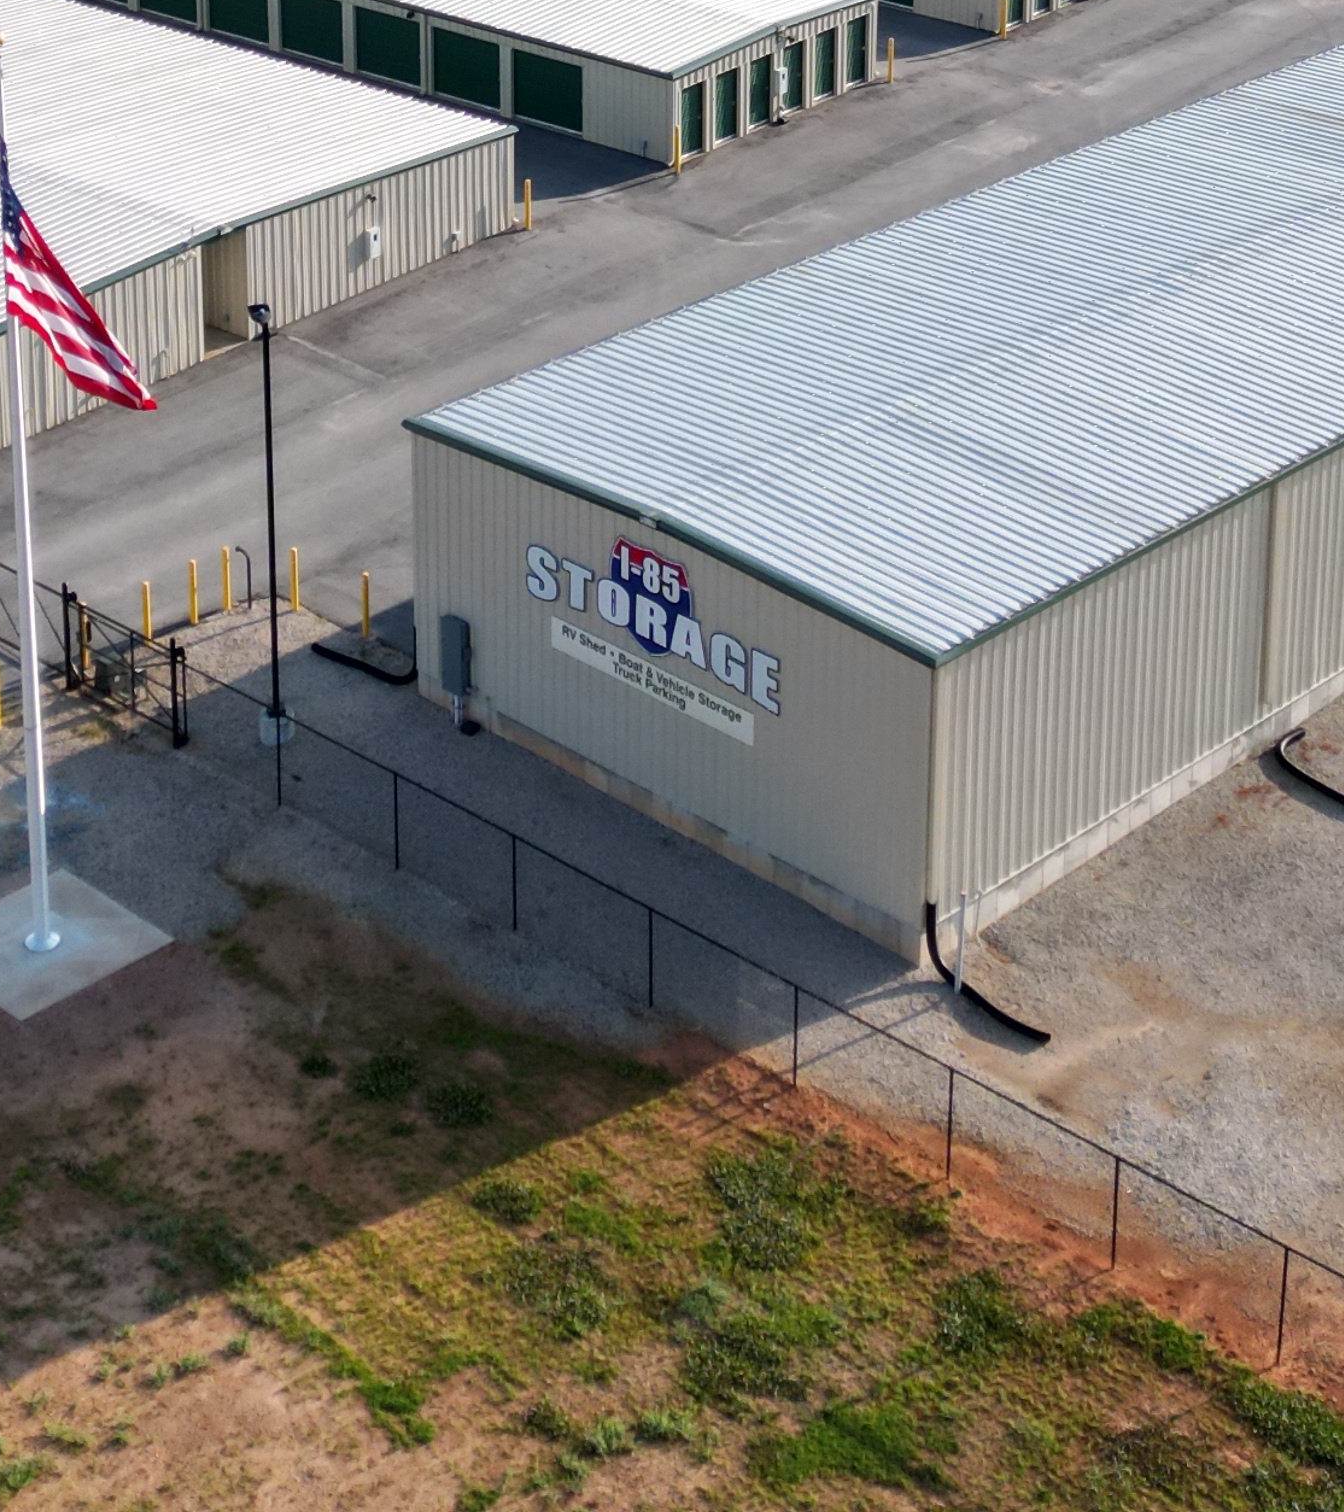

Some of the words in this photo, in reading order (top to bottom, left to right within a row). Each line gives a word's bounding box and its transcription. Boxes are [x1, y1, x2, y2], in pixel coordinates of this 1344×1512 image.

[619, 544, 680, 604] I-85
[526, 544, 781, 717] STORAGE
[562, 624, 577, 641] RV
[579, 634, 607, 656] Shed
[618, 652, 644, 672] Boat
[646, 666, 654, 679] &
[656, 671, 695, 700] Vehicle
[698, 692, 743, 723] Storage
[612, 661, 642, 686] Truck
[645, 678, 686, 711] Parking
